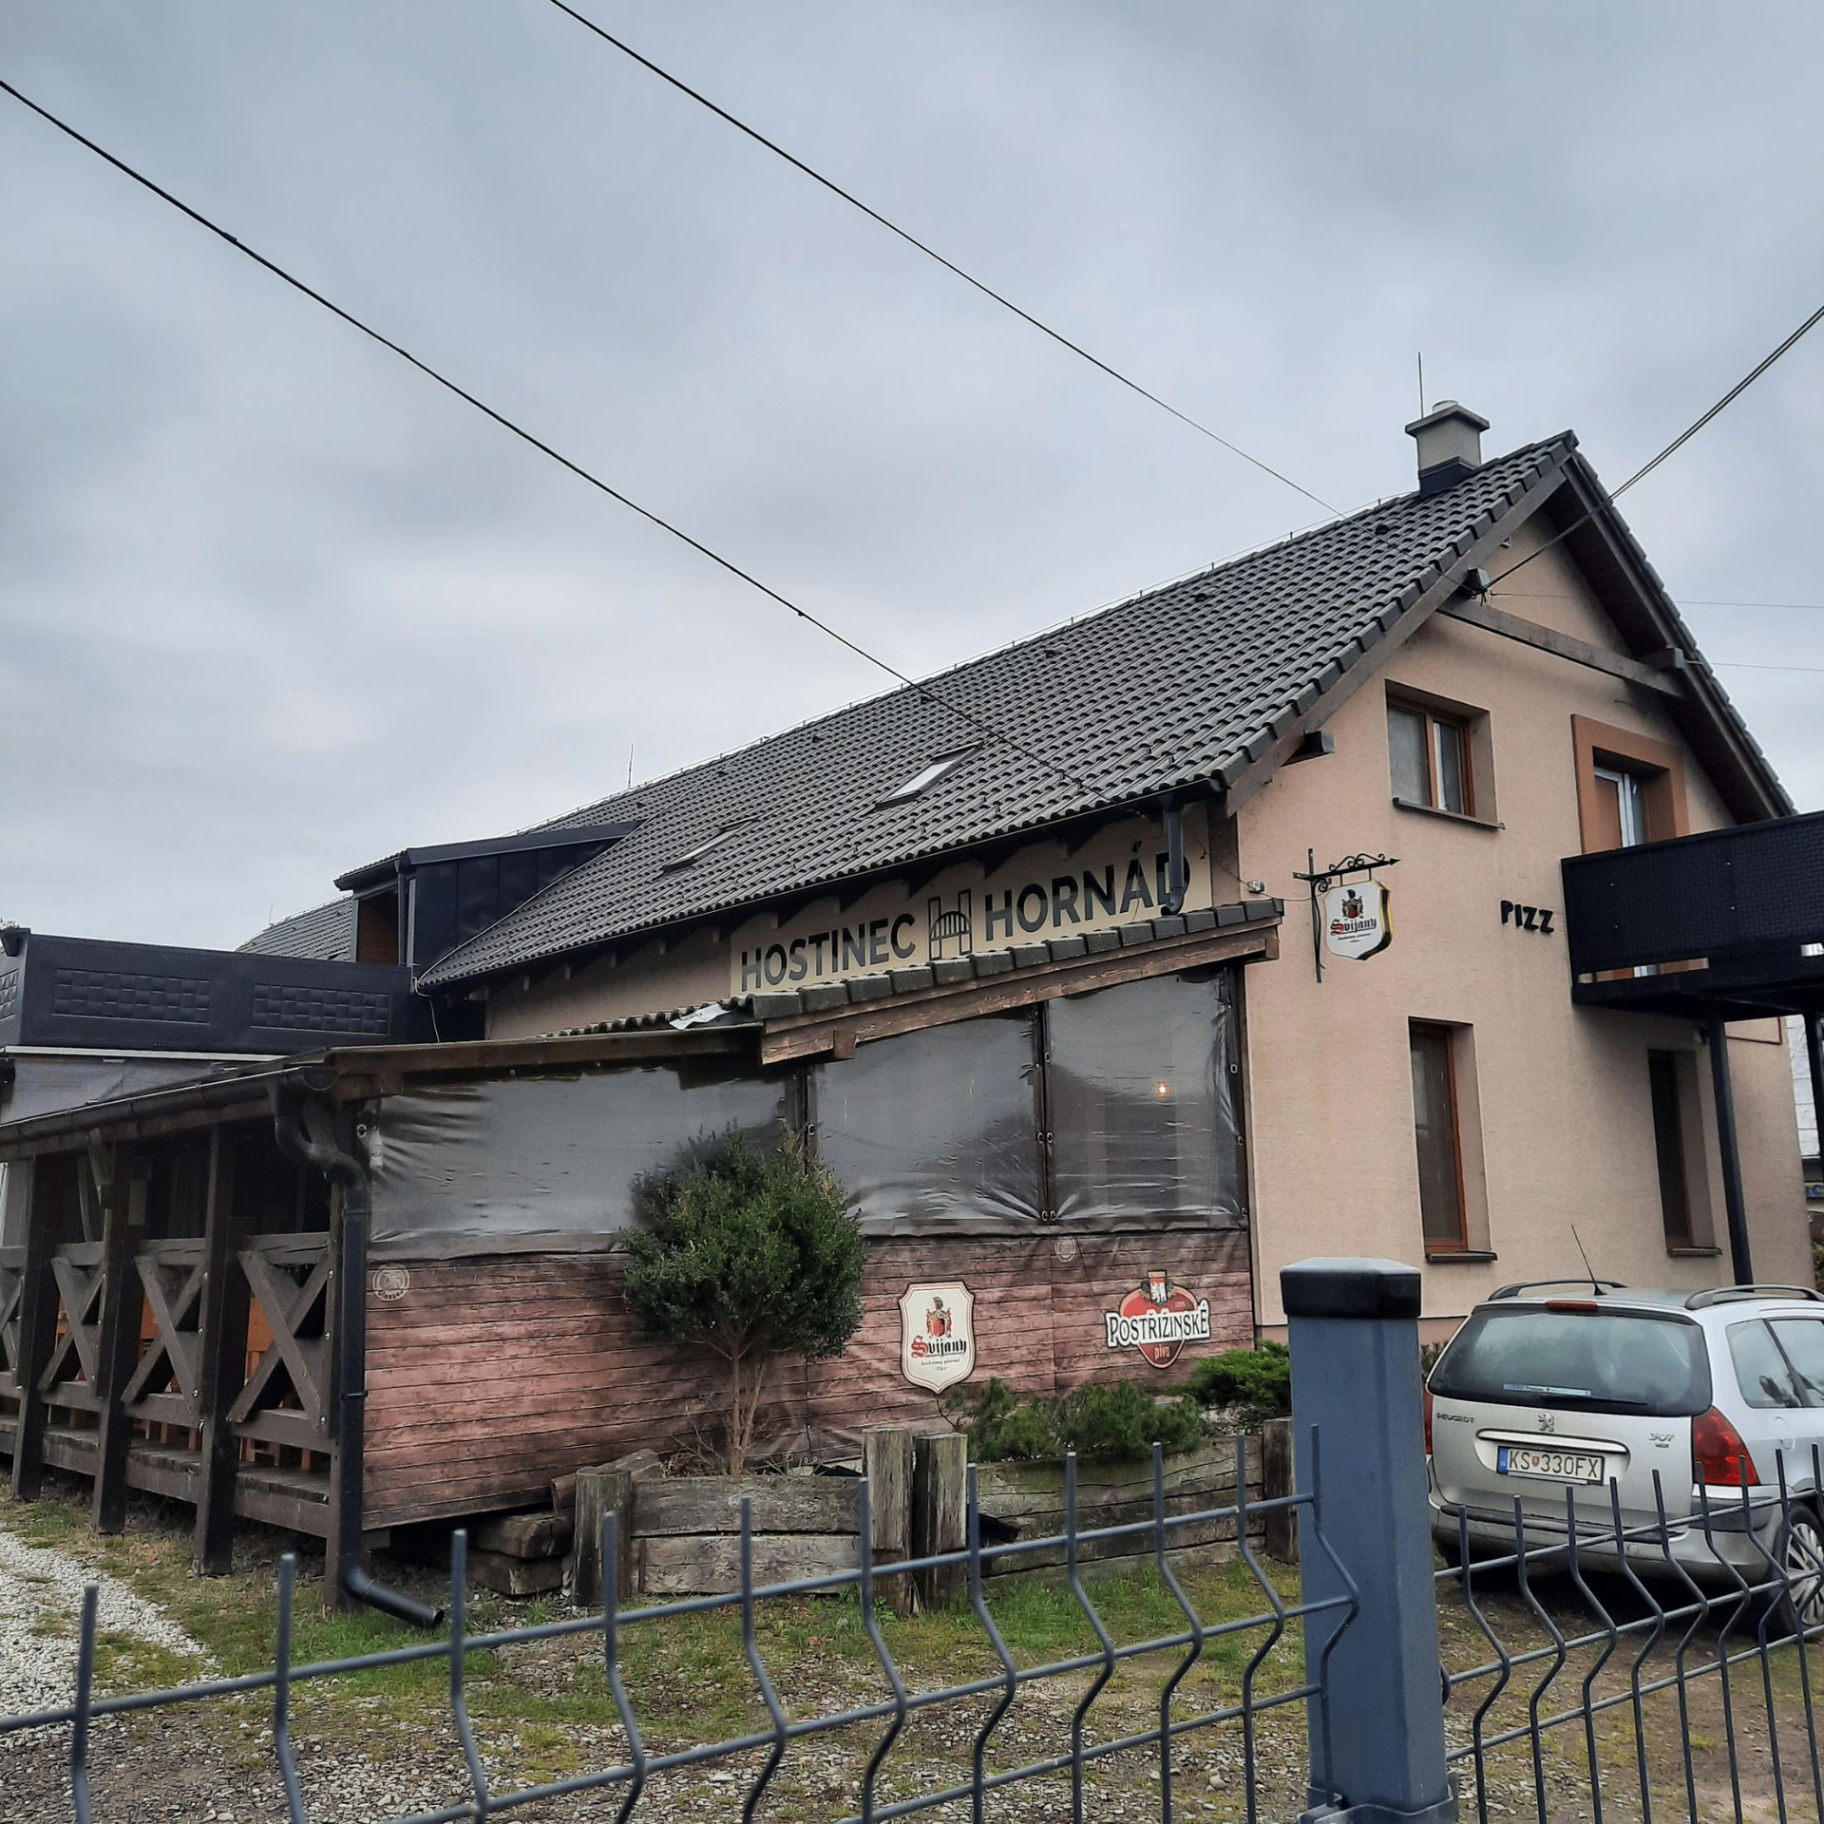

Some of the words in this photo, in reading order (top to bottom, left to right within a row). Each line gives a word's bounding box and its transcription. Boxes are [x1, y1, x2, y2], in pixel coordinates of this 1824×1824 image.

[1330, 917, 1377, 936] Svijany
[1500, 899, 1555, 934] PIZZ
[741, 913, 917, 992] HOSTINEC
[1108, 1303, 1208, 1343] POSTŘIŽINSKÉ
[911, 1335, 967, 1358] Svijany
[1154, 1344, 1171, 1361] pivo
[1648, 1431, 1675, 1442] 307
